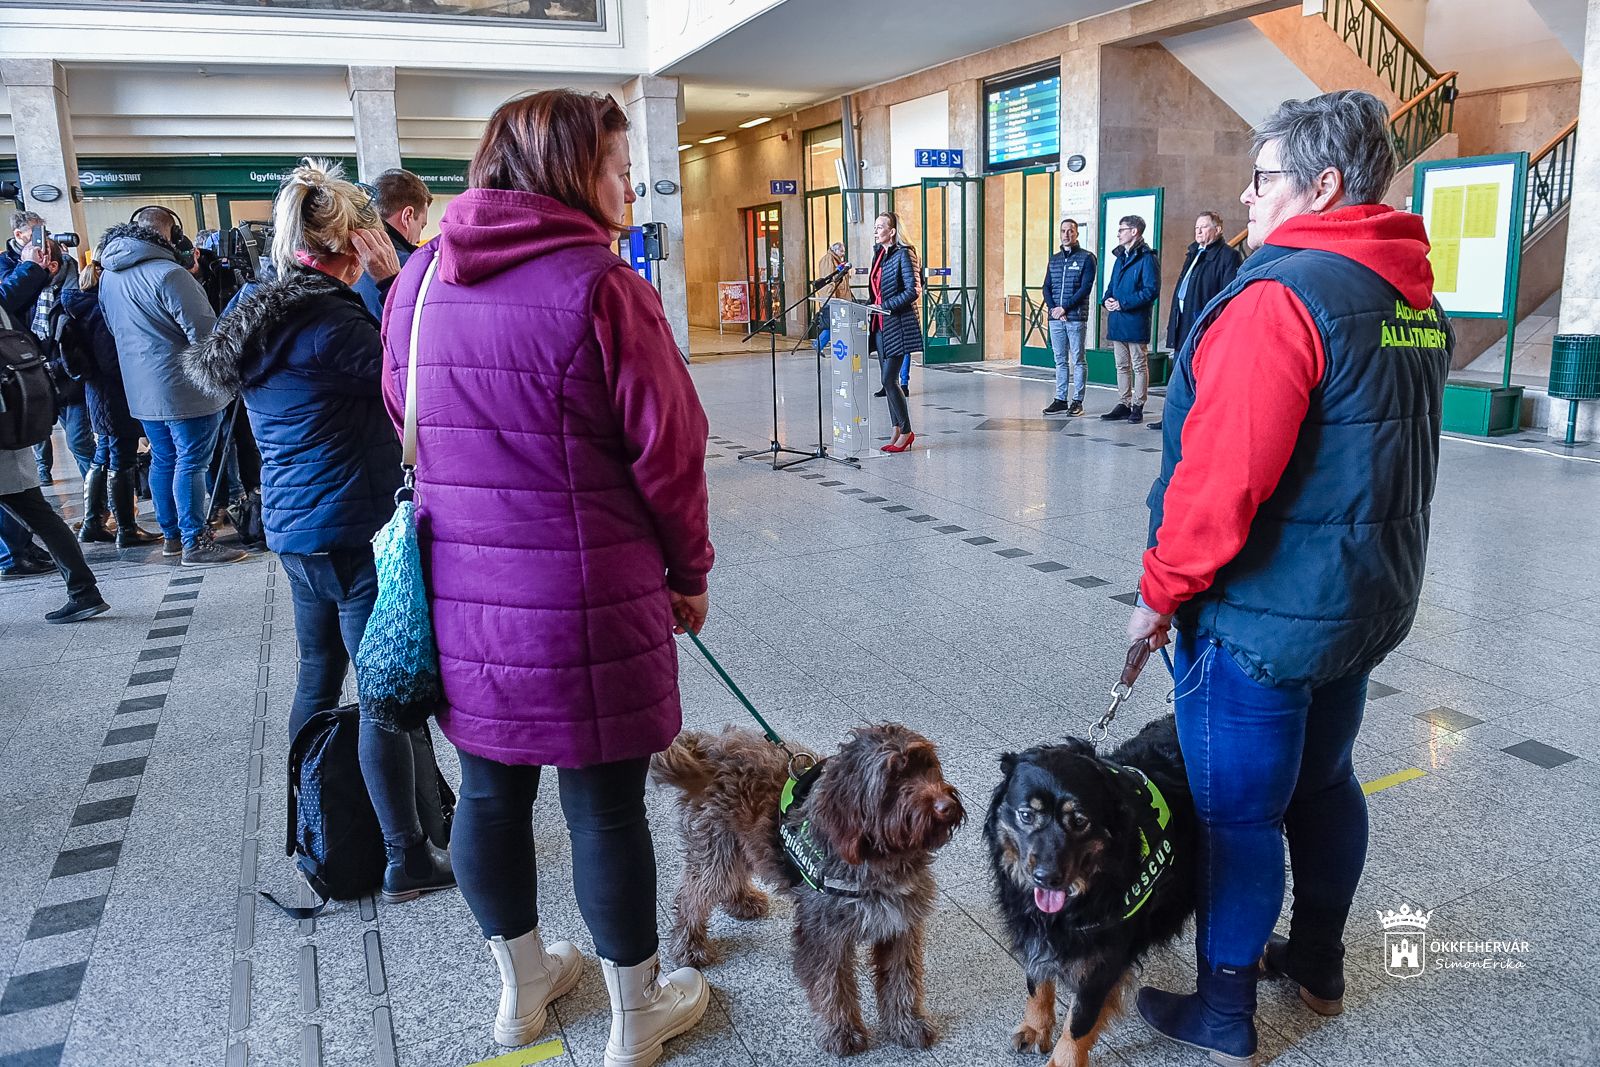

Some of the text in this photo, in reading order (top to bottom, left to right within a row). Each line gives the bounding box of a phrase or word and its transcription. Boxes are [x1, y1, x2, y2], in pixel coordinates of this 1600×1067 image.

[440, 174, 464, 182] service
[775, 182, 780, 191] 1
[1124, 839, 1172, 906] rescue
